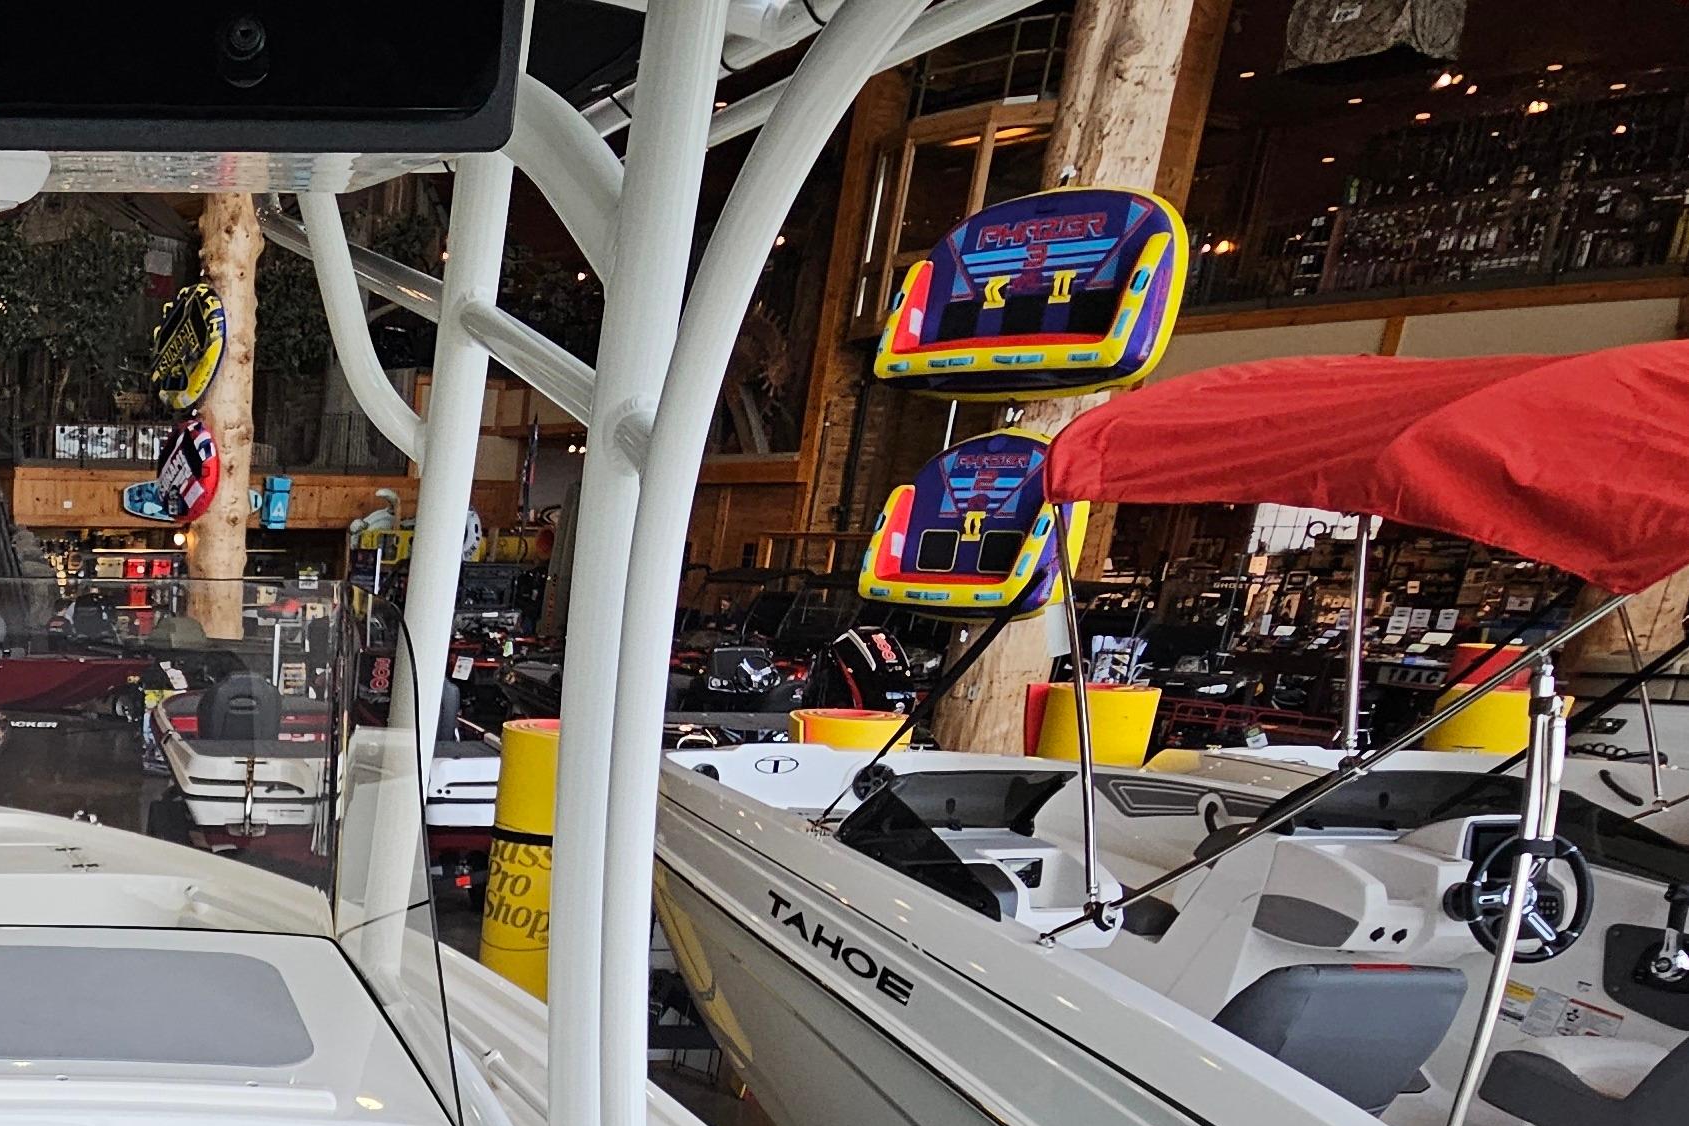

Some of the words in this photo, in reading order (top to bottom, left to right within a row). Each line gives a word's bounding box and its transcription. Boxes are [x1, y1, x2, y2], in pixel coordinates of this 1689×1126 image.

[977, 212, 1107, 250] PHAZER
[1022, 244, 1049, 268] 3
[488, 859, 532, 898] Pro
[768, 889, 915, 1007] TAHOE
